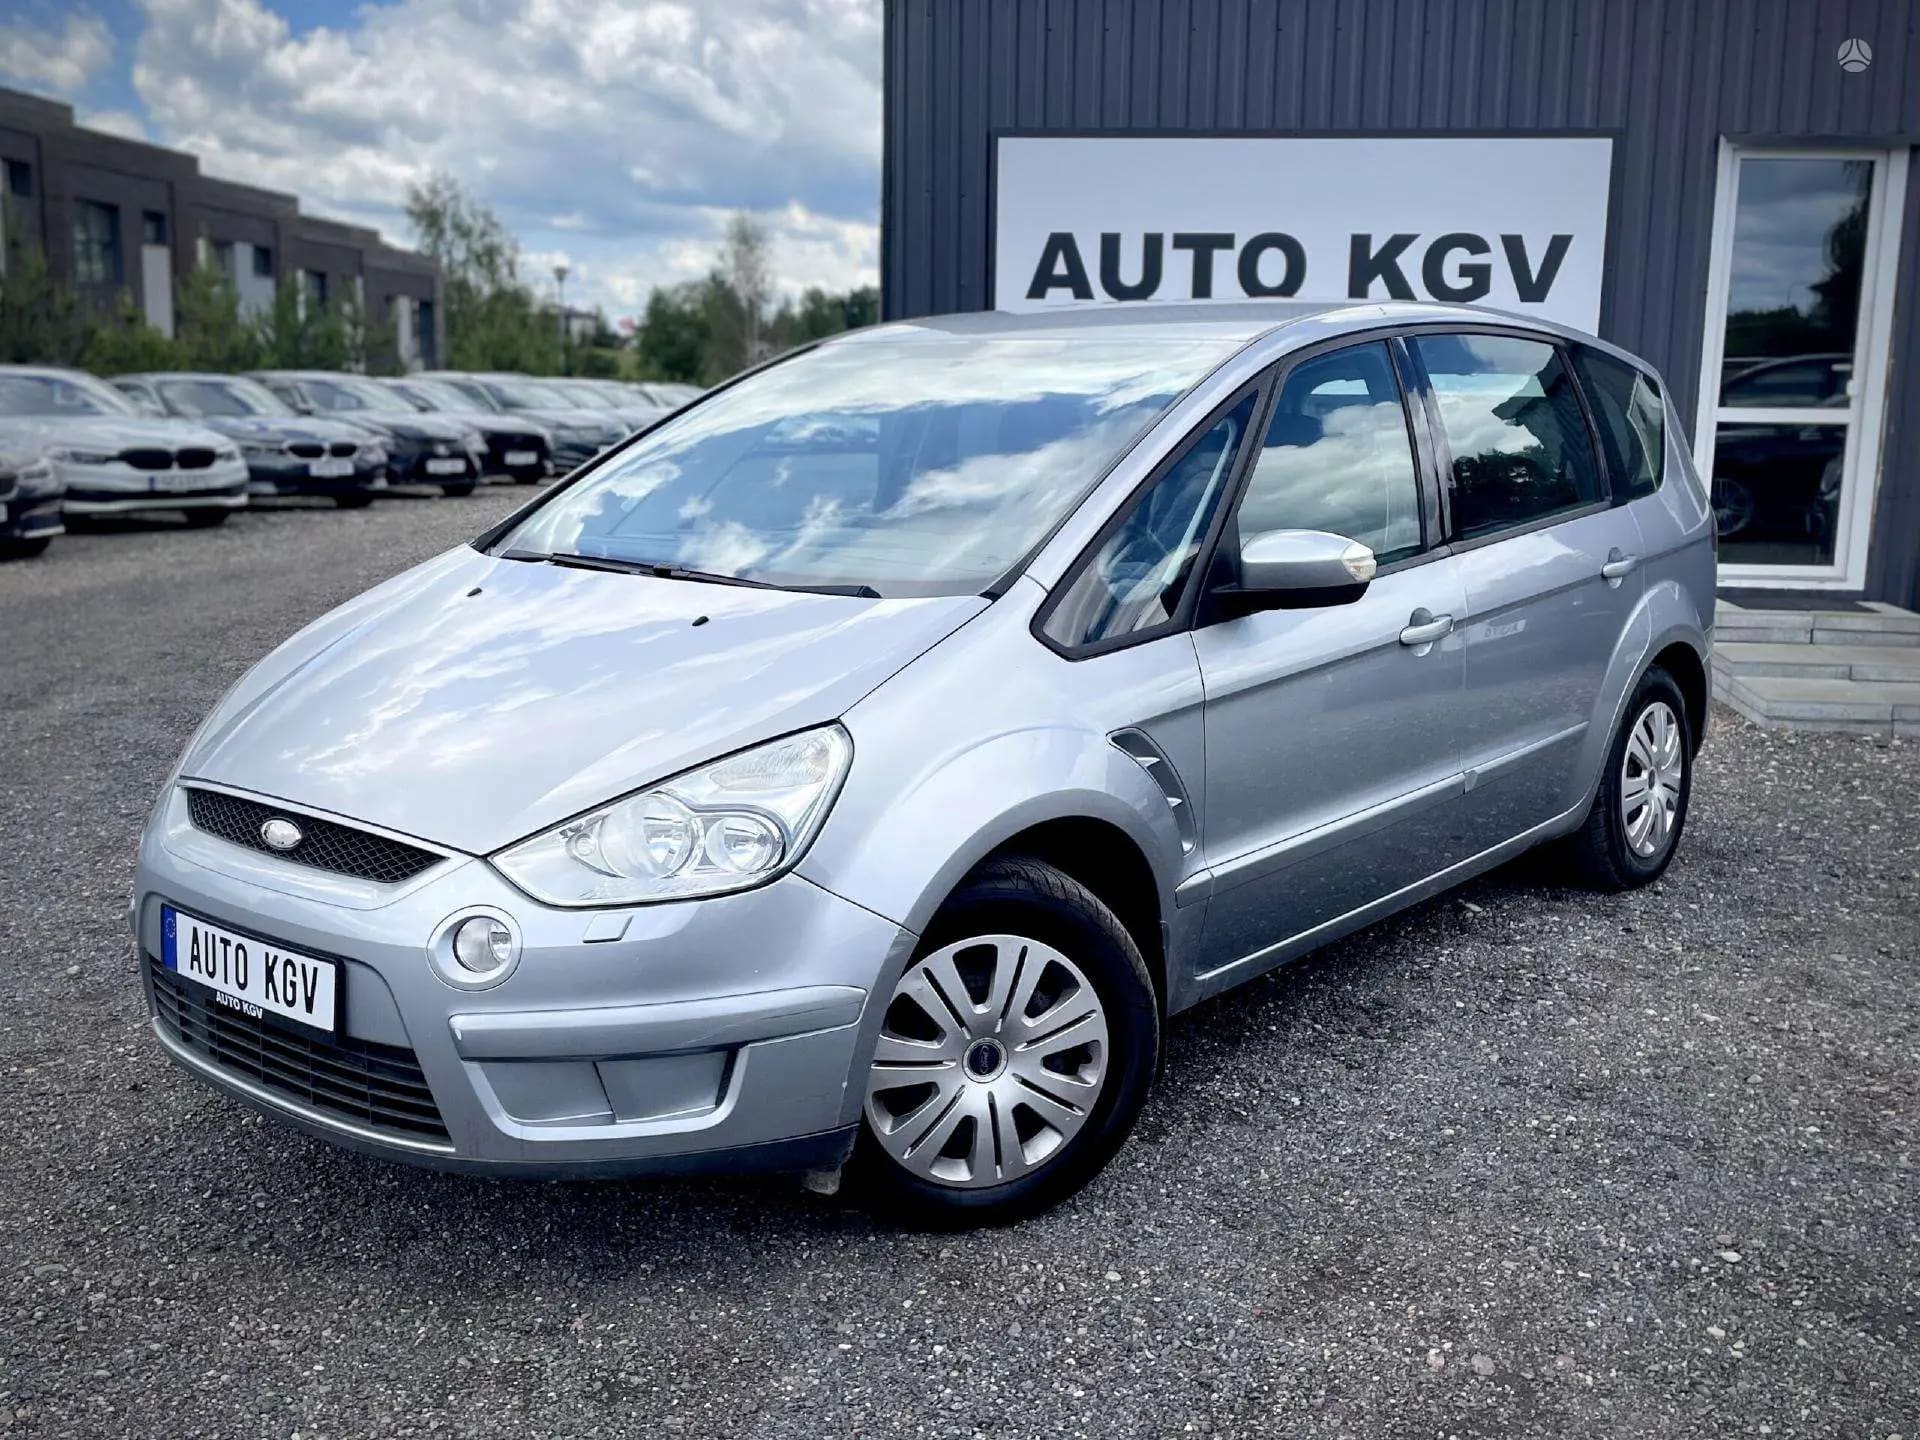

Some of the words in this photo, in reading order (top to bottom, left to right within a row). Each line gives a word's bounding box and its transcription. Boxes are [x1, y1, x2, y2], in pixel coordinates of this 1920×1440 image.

[1025, 232, 1307, 301] AUTO
[1347, 232, 1574, 303] KGV
[190, 927, 248, 990] AUTO
[265, 952, 318, 1014] KGV
[216, 991, 241, 1010] AUTO
[242, 1002, 263, 1019] KGV
